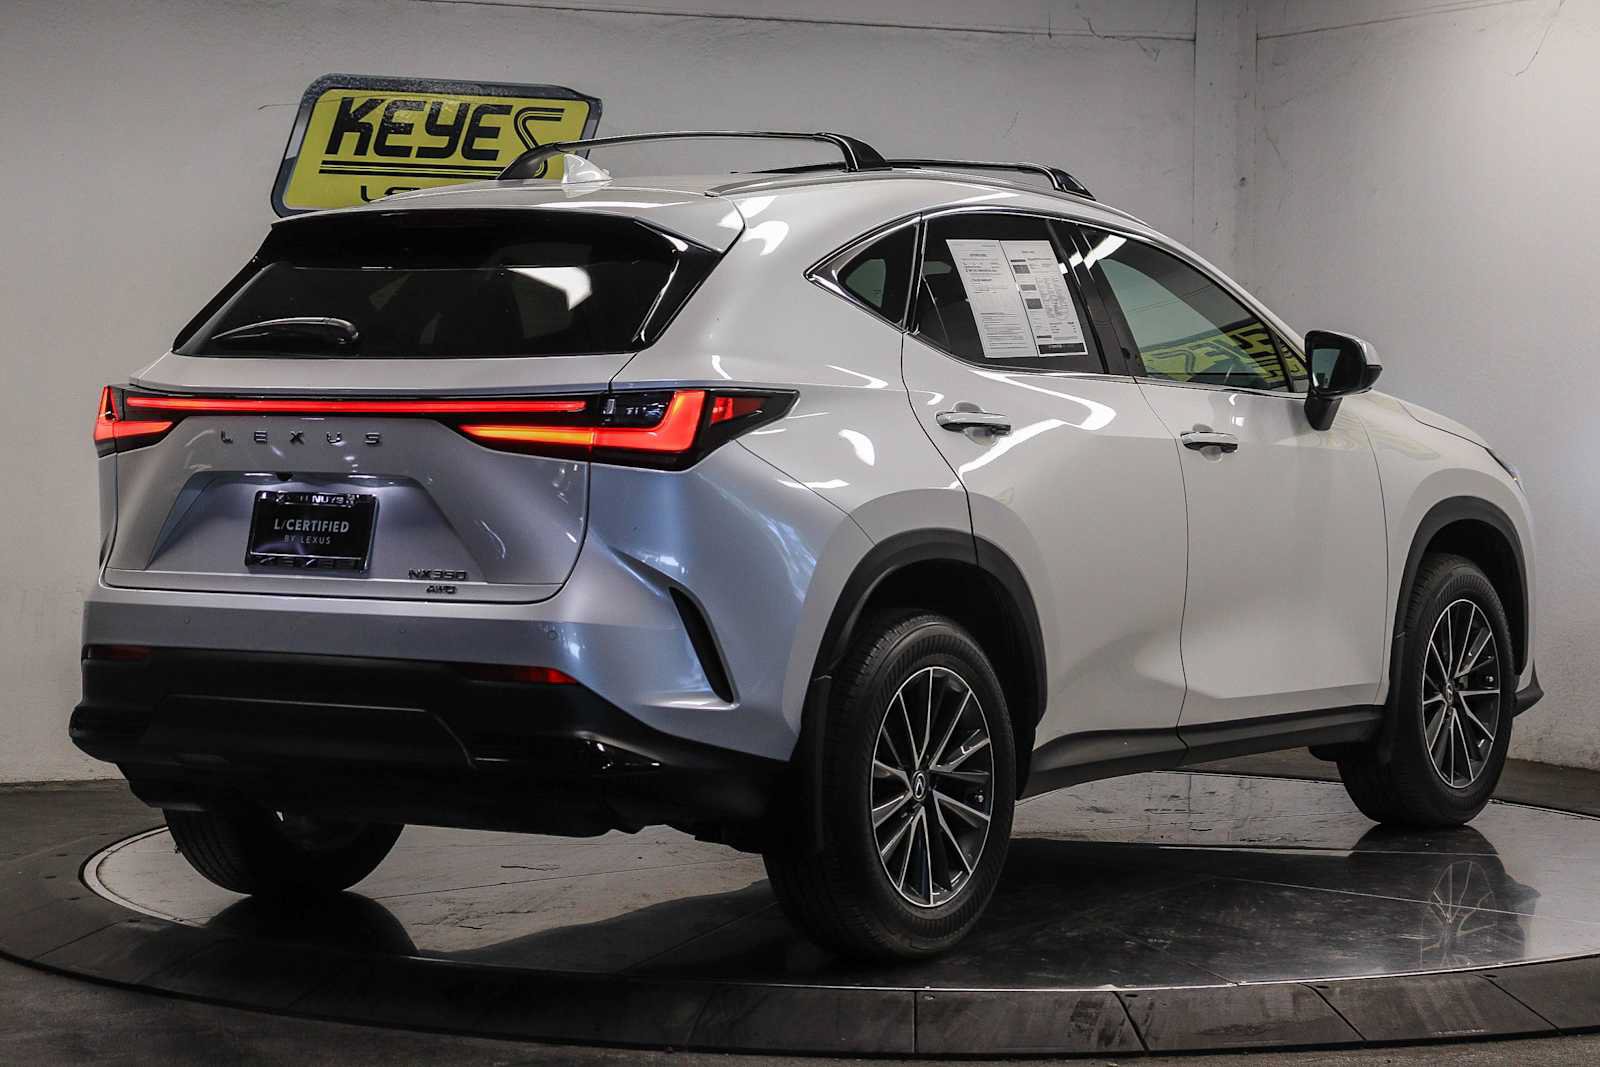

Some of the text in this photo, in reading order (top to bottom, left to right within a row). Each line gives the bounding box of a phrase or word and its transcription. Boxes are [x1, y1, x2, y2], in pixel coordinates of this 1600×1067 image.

[324, 96, 566, 178] KEYES
[220, 430, 381, 445] LEXUS
[284, 534, 331, 545] BY LEXUS
